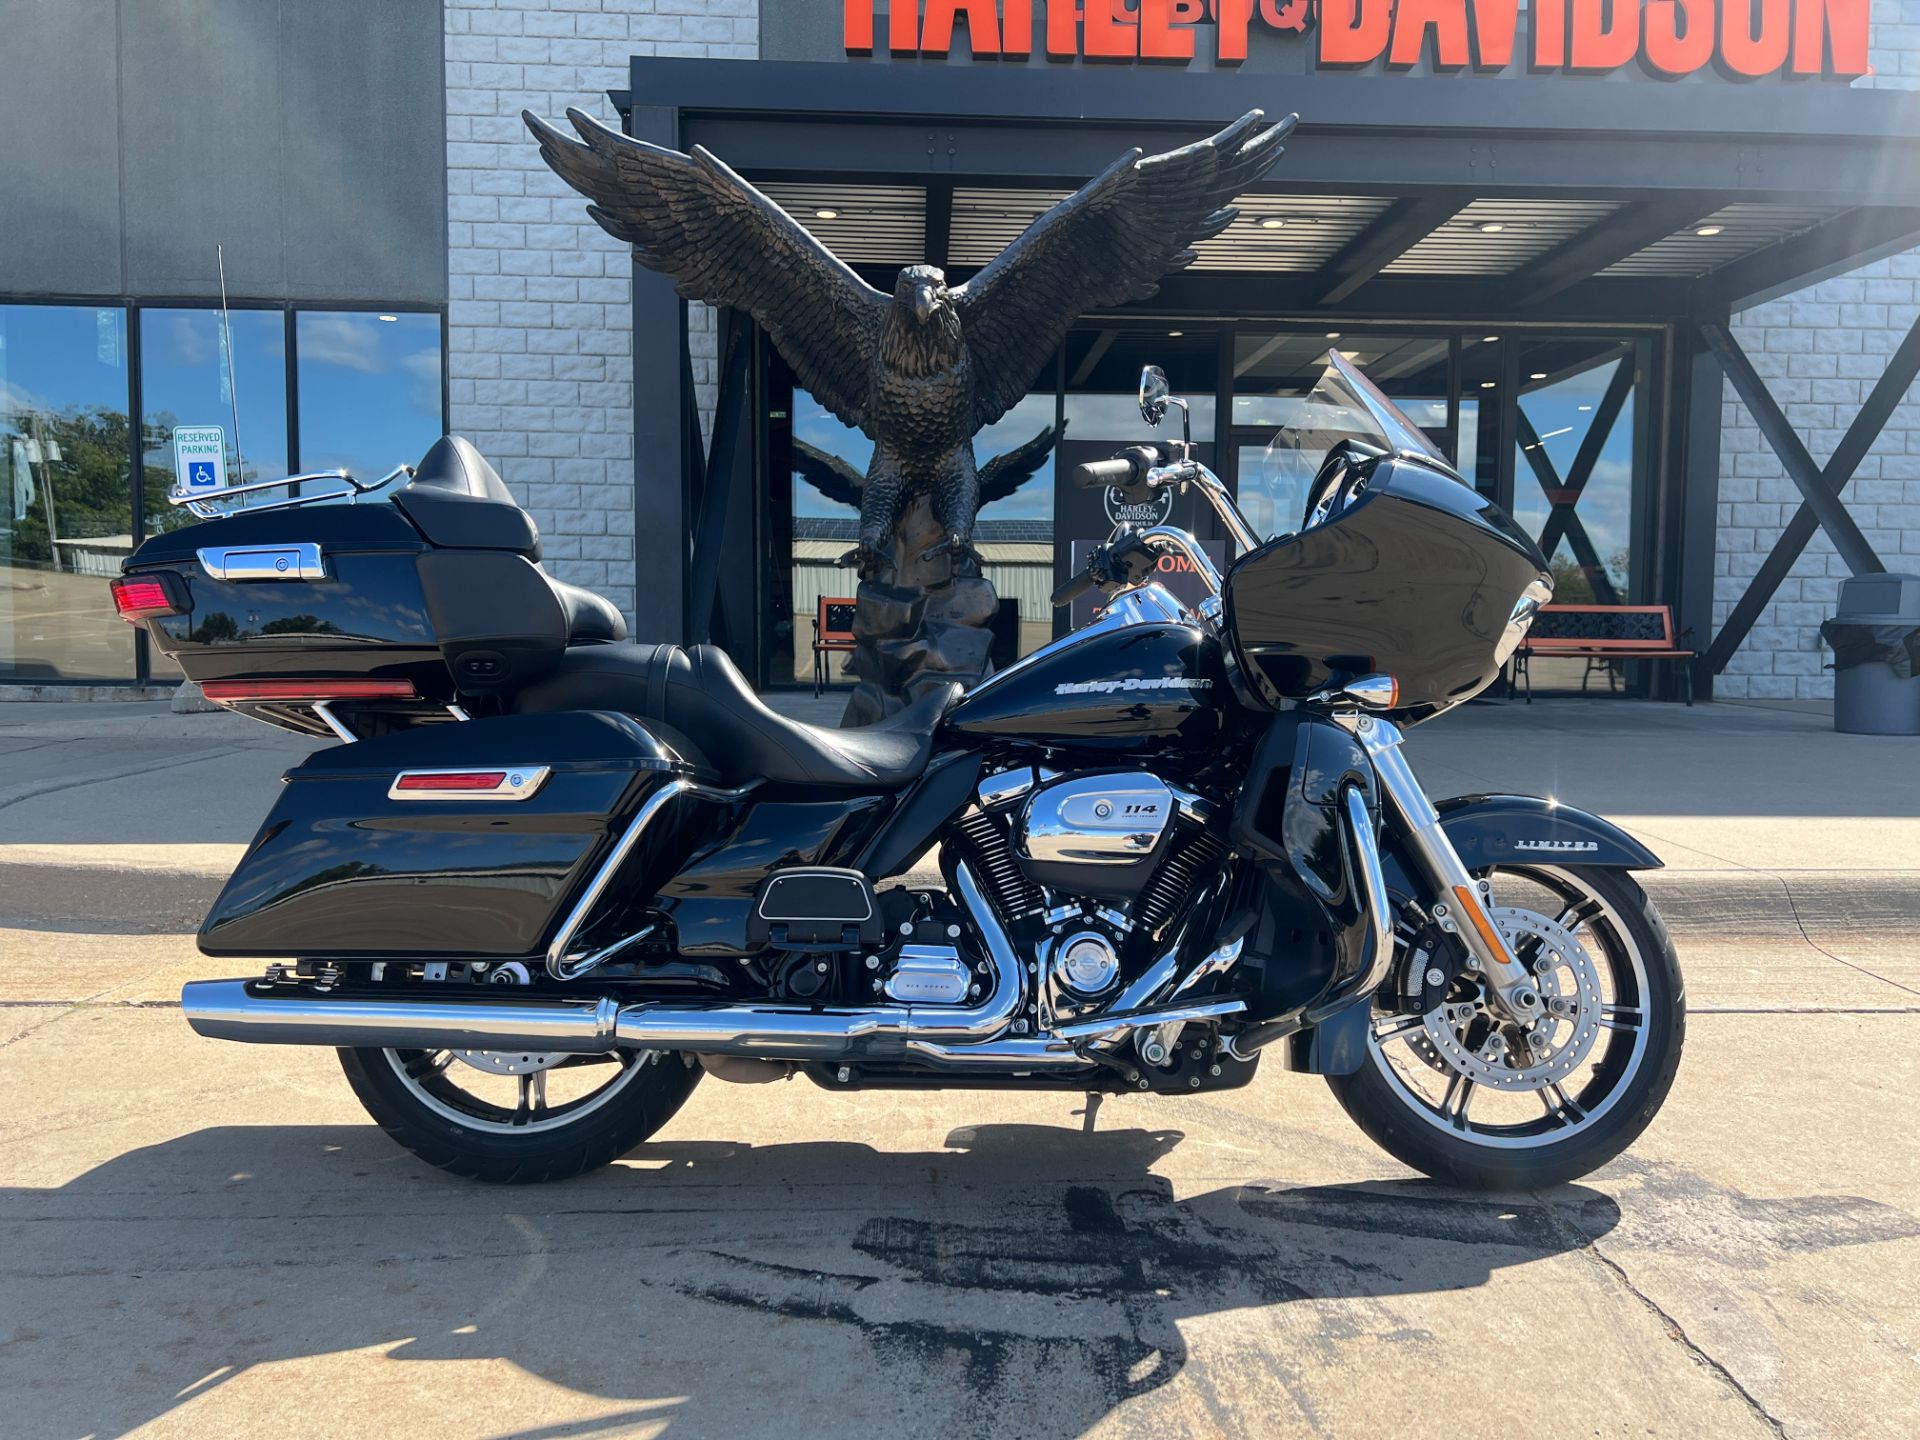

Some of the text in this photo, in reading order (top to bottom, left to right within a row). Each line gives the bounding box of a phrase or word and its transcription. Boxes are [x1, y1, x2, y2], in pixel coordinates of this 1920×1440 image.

[177, 433, 220, 442] RESERVED
[181, 445, 218, 454] PARKING
[1115, 512, 1158, 520] DAVIDSON
[1125, 805, 1157, 813] 114
[1514, 840, 1599, 851] LIMITED
